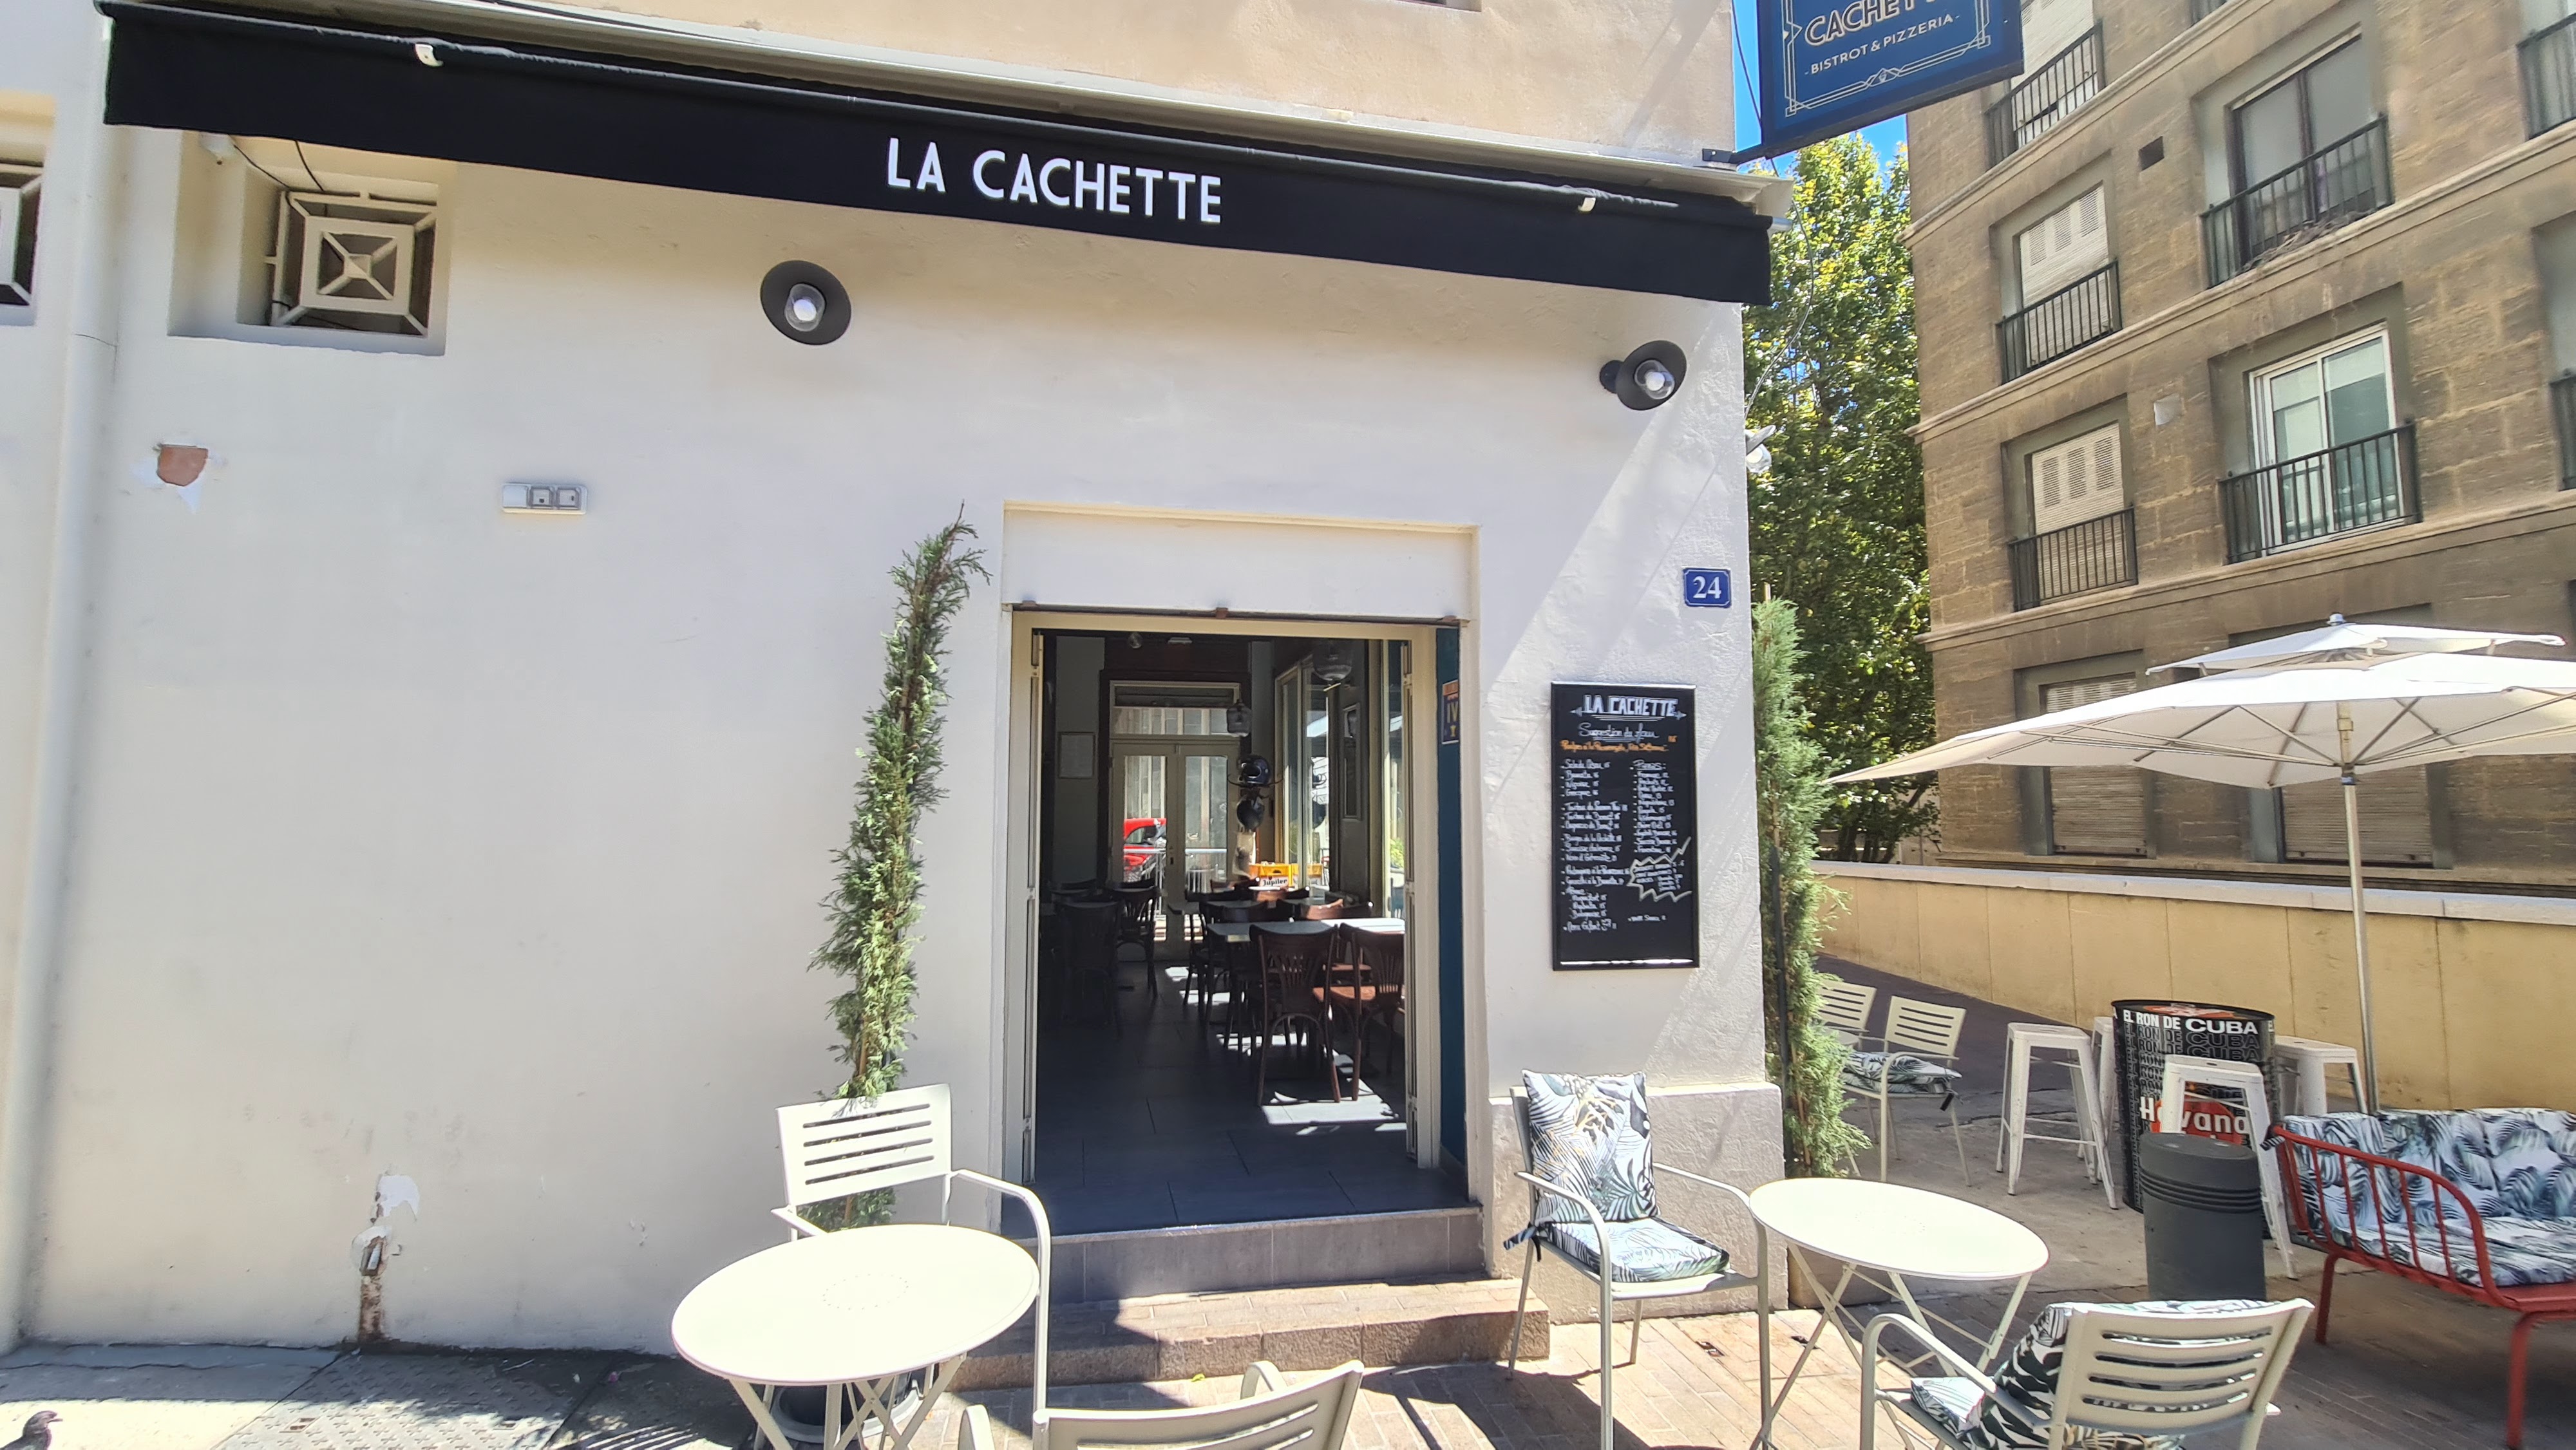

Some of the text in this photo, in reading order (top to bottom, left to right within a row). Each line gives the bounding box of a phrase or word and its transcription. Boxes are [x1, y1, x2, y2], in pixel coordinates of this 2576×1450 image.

[1811, 14, 1953, 74] BISTROT & PIZZERIA
[888, 137, 1222, 223] LA CACHETTE
[1692, 576, 1721, 599] 24
[1583, 695, 1678, 717] LA CACHETTE
[1262, 878, 1288, 887] Jupiler
[2123, 1009, 2134, 1023] EL
[2136, 1012, 2159, 1028] RON
[2163, 1015, 2181, 1030] DE
[2185, 1018, 2259, 1035] CUBA
[2136, 1024, 2161, 1042] RON
[2164, 1030, 2183, 1044] DE
[2186, 1031, 2260, 1049] CUBA
[2137, 1037, 2162, 1054] RON
